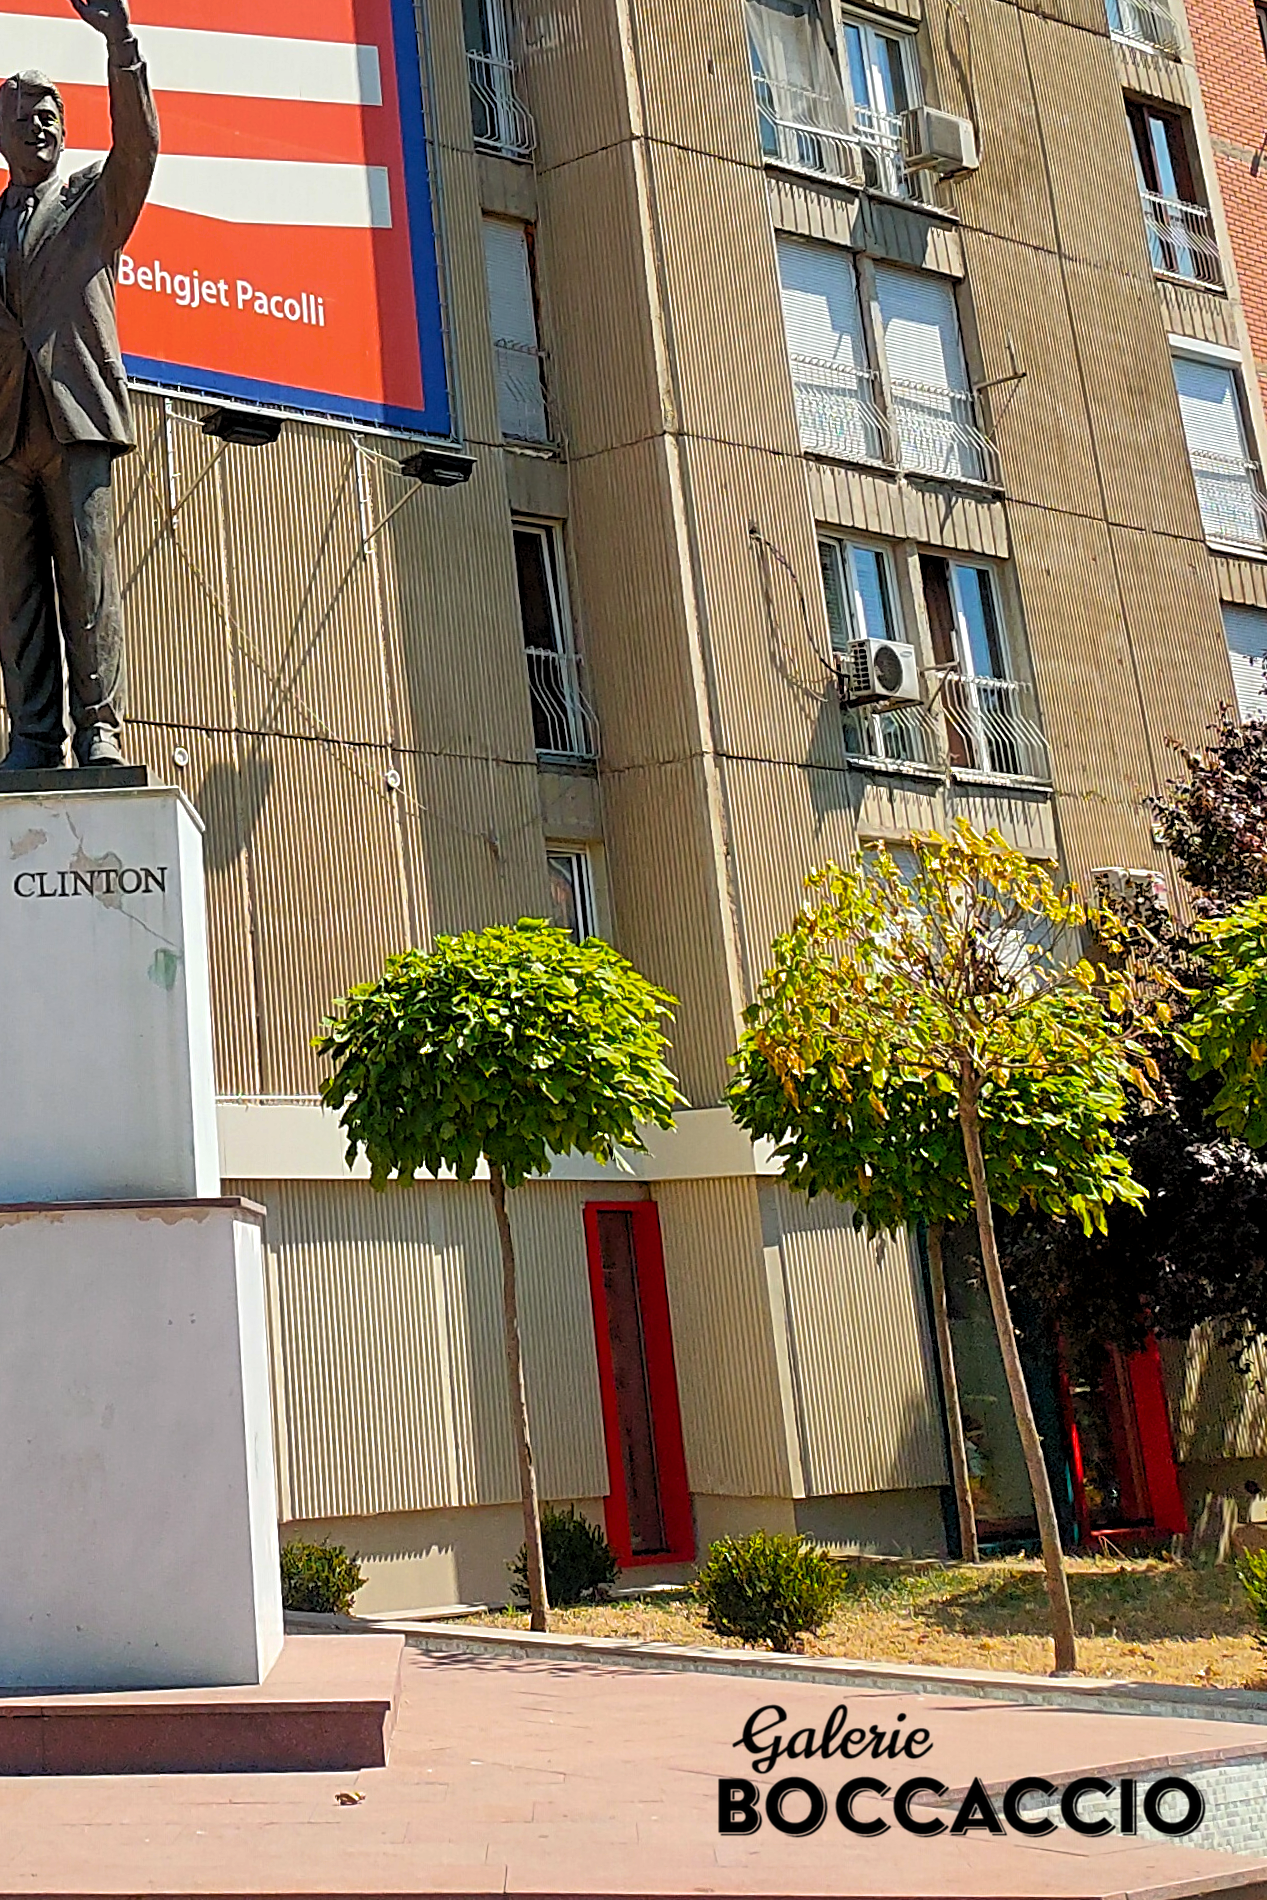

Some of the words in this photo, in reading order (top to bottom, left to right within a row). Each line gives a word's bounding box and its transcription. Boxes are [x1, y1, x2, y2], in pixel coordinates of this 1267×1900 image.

[117, 254, 229, 309] Behgjet
[236, 279, 325, 327] Pacolli
[13, 866, 168, 899] CLINTON
